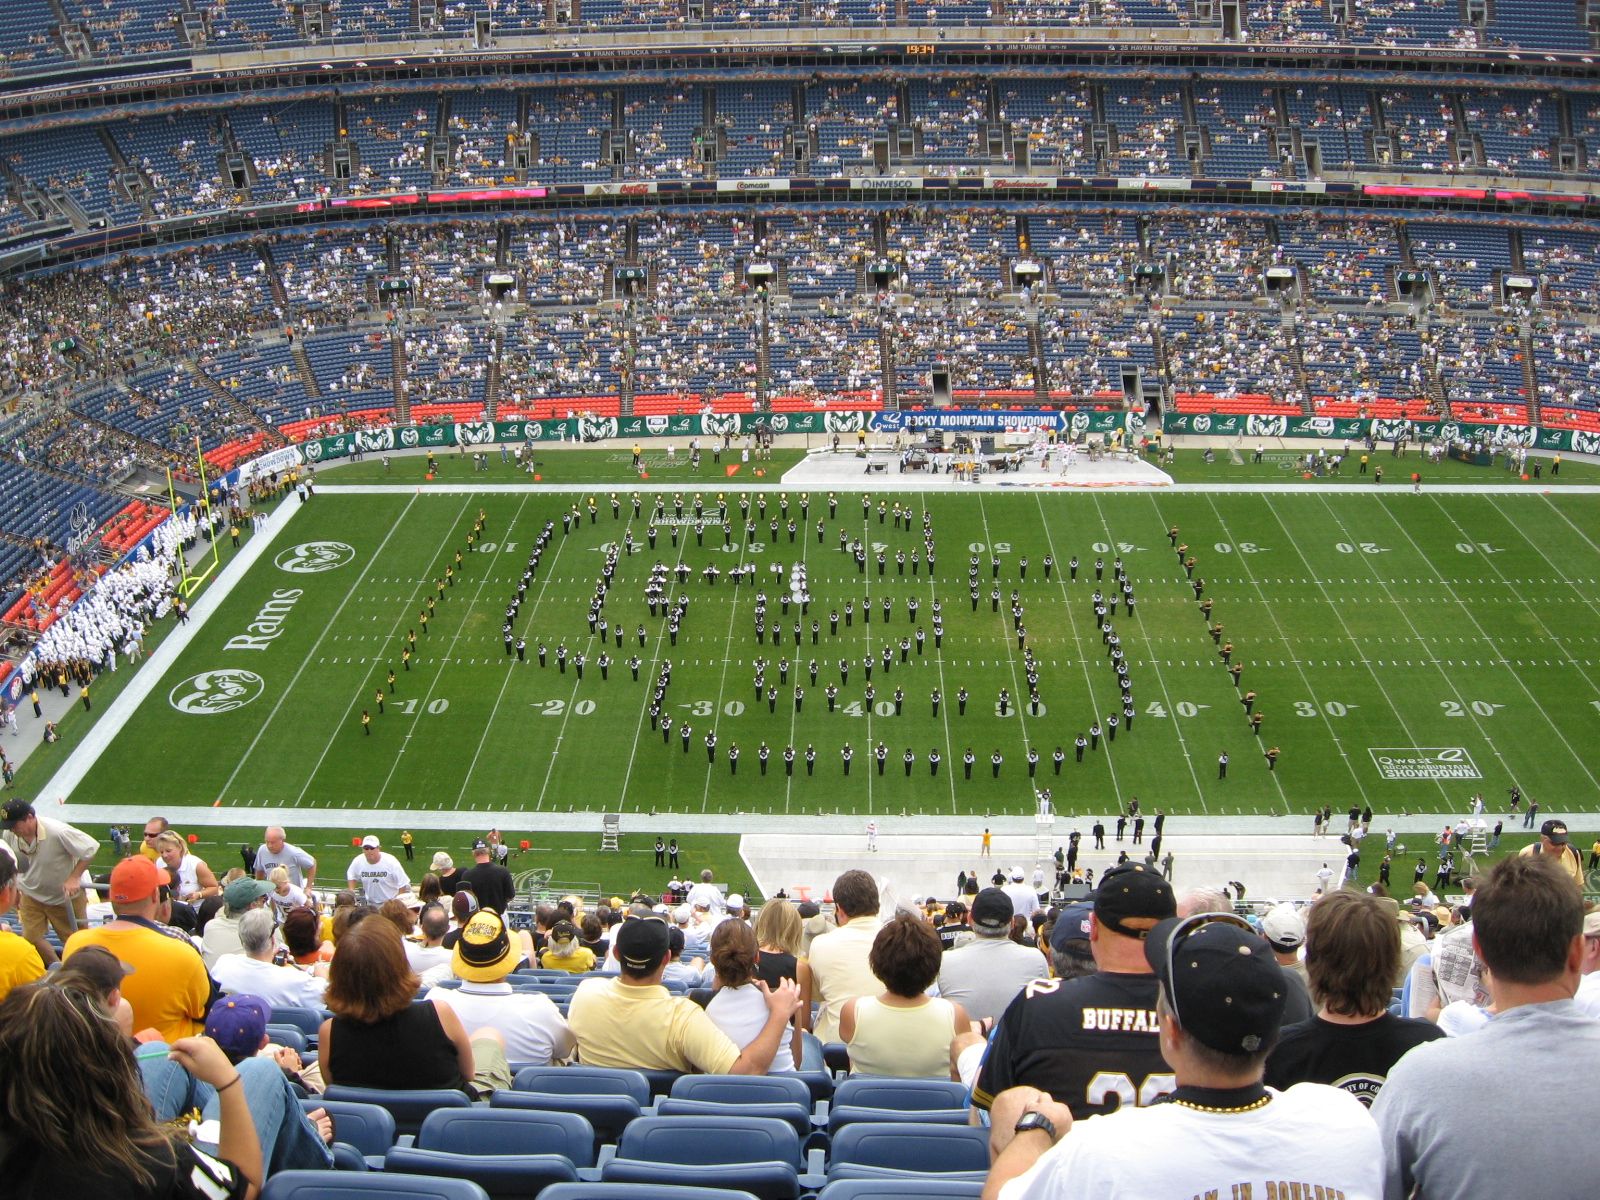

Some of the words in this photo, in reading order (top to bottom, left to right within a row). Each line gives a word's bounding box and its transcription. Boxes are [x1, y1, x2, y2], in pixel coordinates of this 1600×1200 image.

[906, 45, 935, 54] 19:34
[111, 81, 139, 90] GERALD
[147, 78, 172, 86] PHIPPS
[872, 180, 913, 188] INVESCO
[992, 179, 1049, 188] Budweiser
[875, 421, 900, 430] Qwest
[904, 415, 937, 427] ROCKY
[940, 415, 995, 427] MOUNTAIN
[997, 415, 1058, 427] SHOWDOWN
[259, 453, 295, 469] SHOWDOWN
[66, 517, 97, 556] Allstate
[480, 542, 518, 554] 10
[722, 542, 766, 554] 30
[968, 542, 1011, 554] 50
[1091, 542, 1134, 554] 40
[1214, 542, 1258, 554] 30
[1335, 542, 1380, 554] 20
[1455, 542, 1497, 554] 10
[222, 588, 304, 651] Rams
[401, 699, 450, 714] 10
[541, 700, 597, 715] 20
[691, 700, 746, 716] 30
[843, 701, 897, 717] 40
[994, 702, 1047, 717] 50
[1145, 701, 1199, 717] 40
[1293, 701, 1348, 717] 30
[1439, 700, 1496, 717] 20
[1378, 756, 1433, 766] Qwest
[1385, 769, 1476, 778] SHOWDOWN
[1082, 1007, 1161, 1033] BUFFAL
[1359, 1082, 1369, 1090] OF
[1370, 1084, 1381, 1093] CO
[1231, 1182, 1252, 1200] IN
[1265, 1180, 1345, 1200] BOULDER
